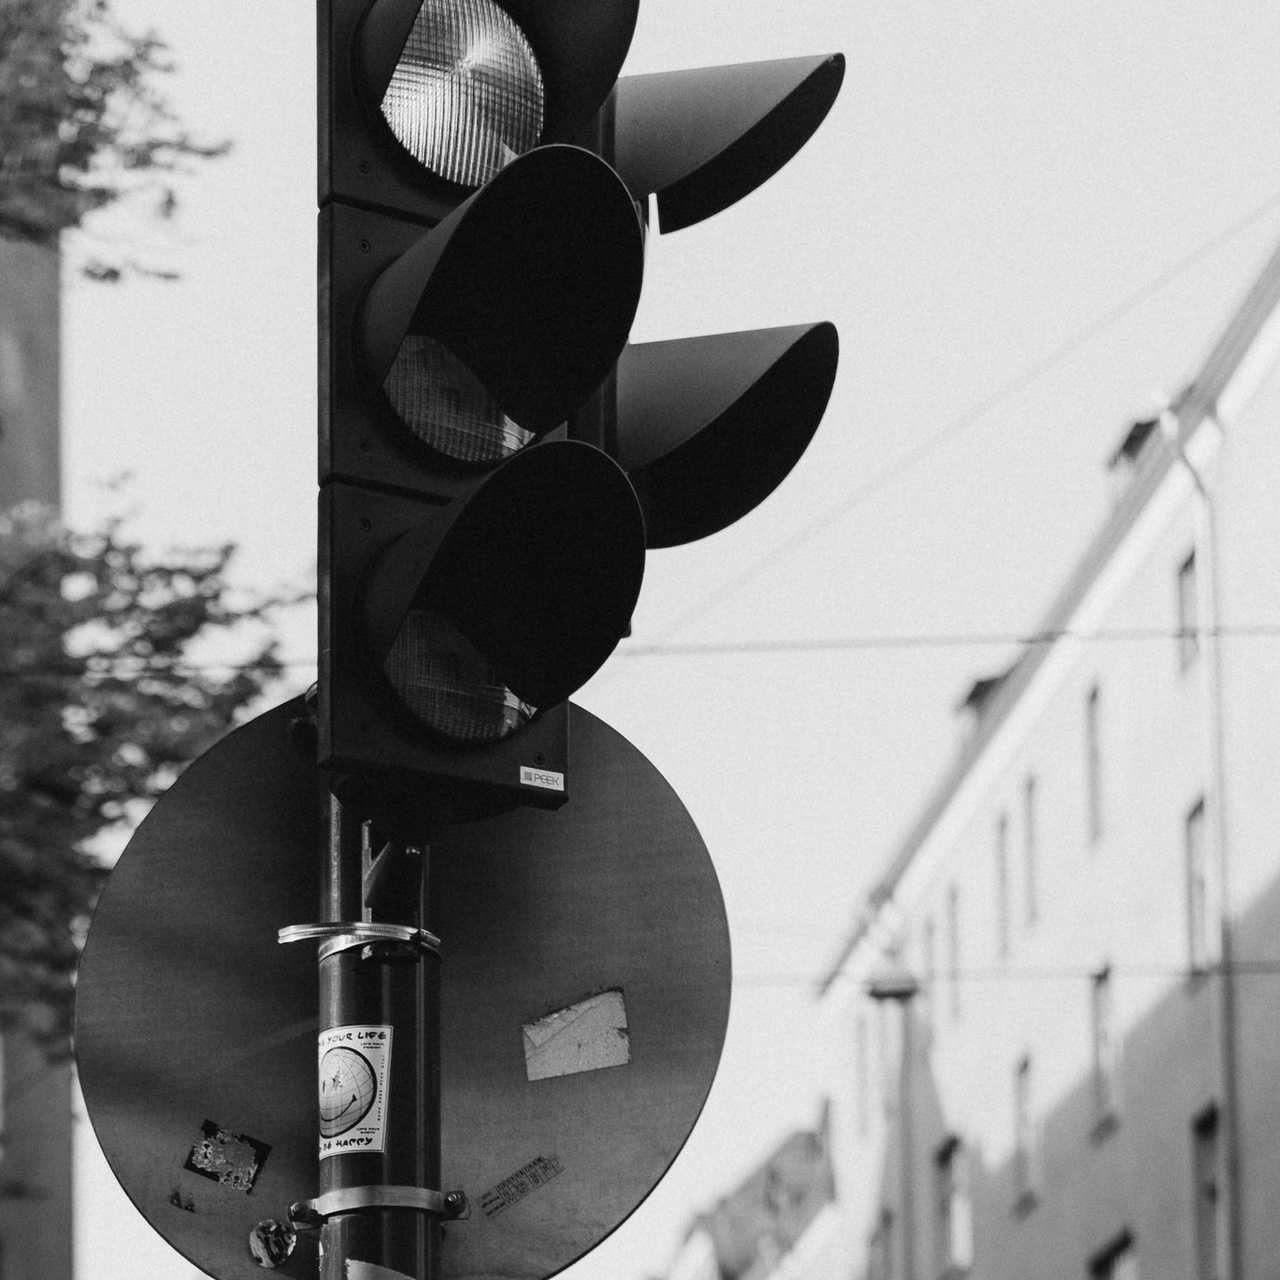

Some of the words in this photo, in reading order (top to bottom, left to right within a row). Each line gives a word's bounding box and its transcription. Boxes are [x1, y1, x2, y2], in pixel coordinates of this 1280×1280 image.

[533, 773, 560, 786] PEEK
[327, 1033, 352, 1044] YOUR
[357, 1031, 386, 1040] LIFE
[336, 1137, 373, 1147] HAPPY
